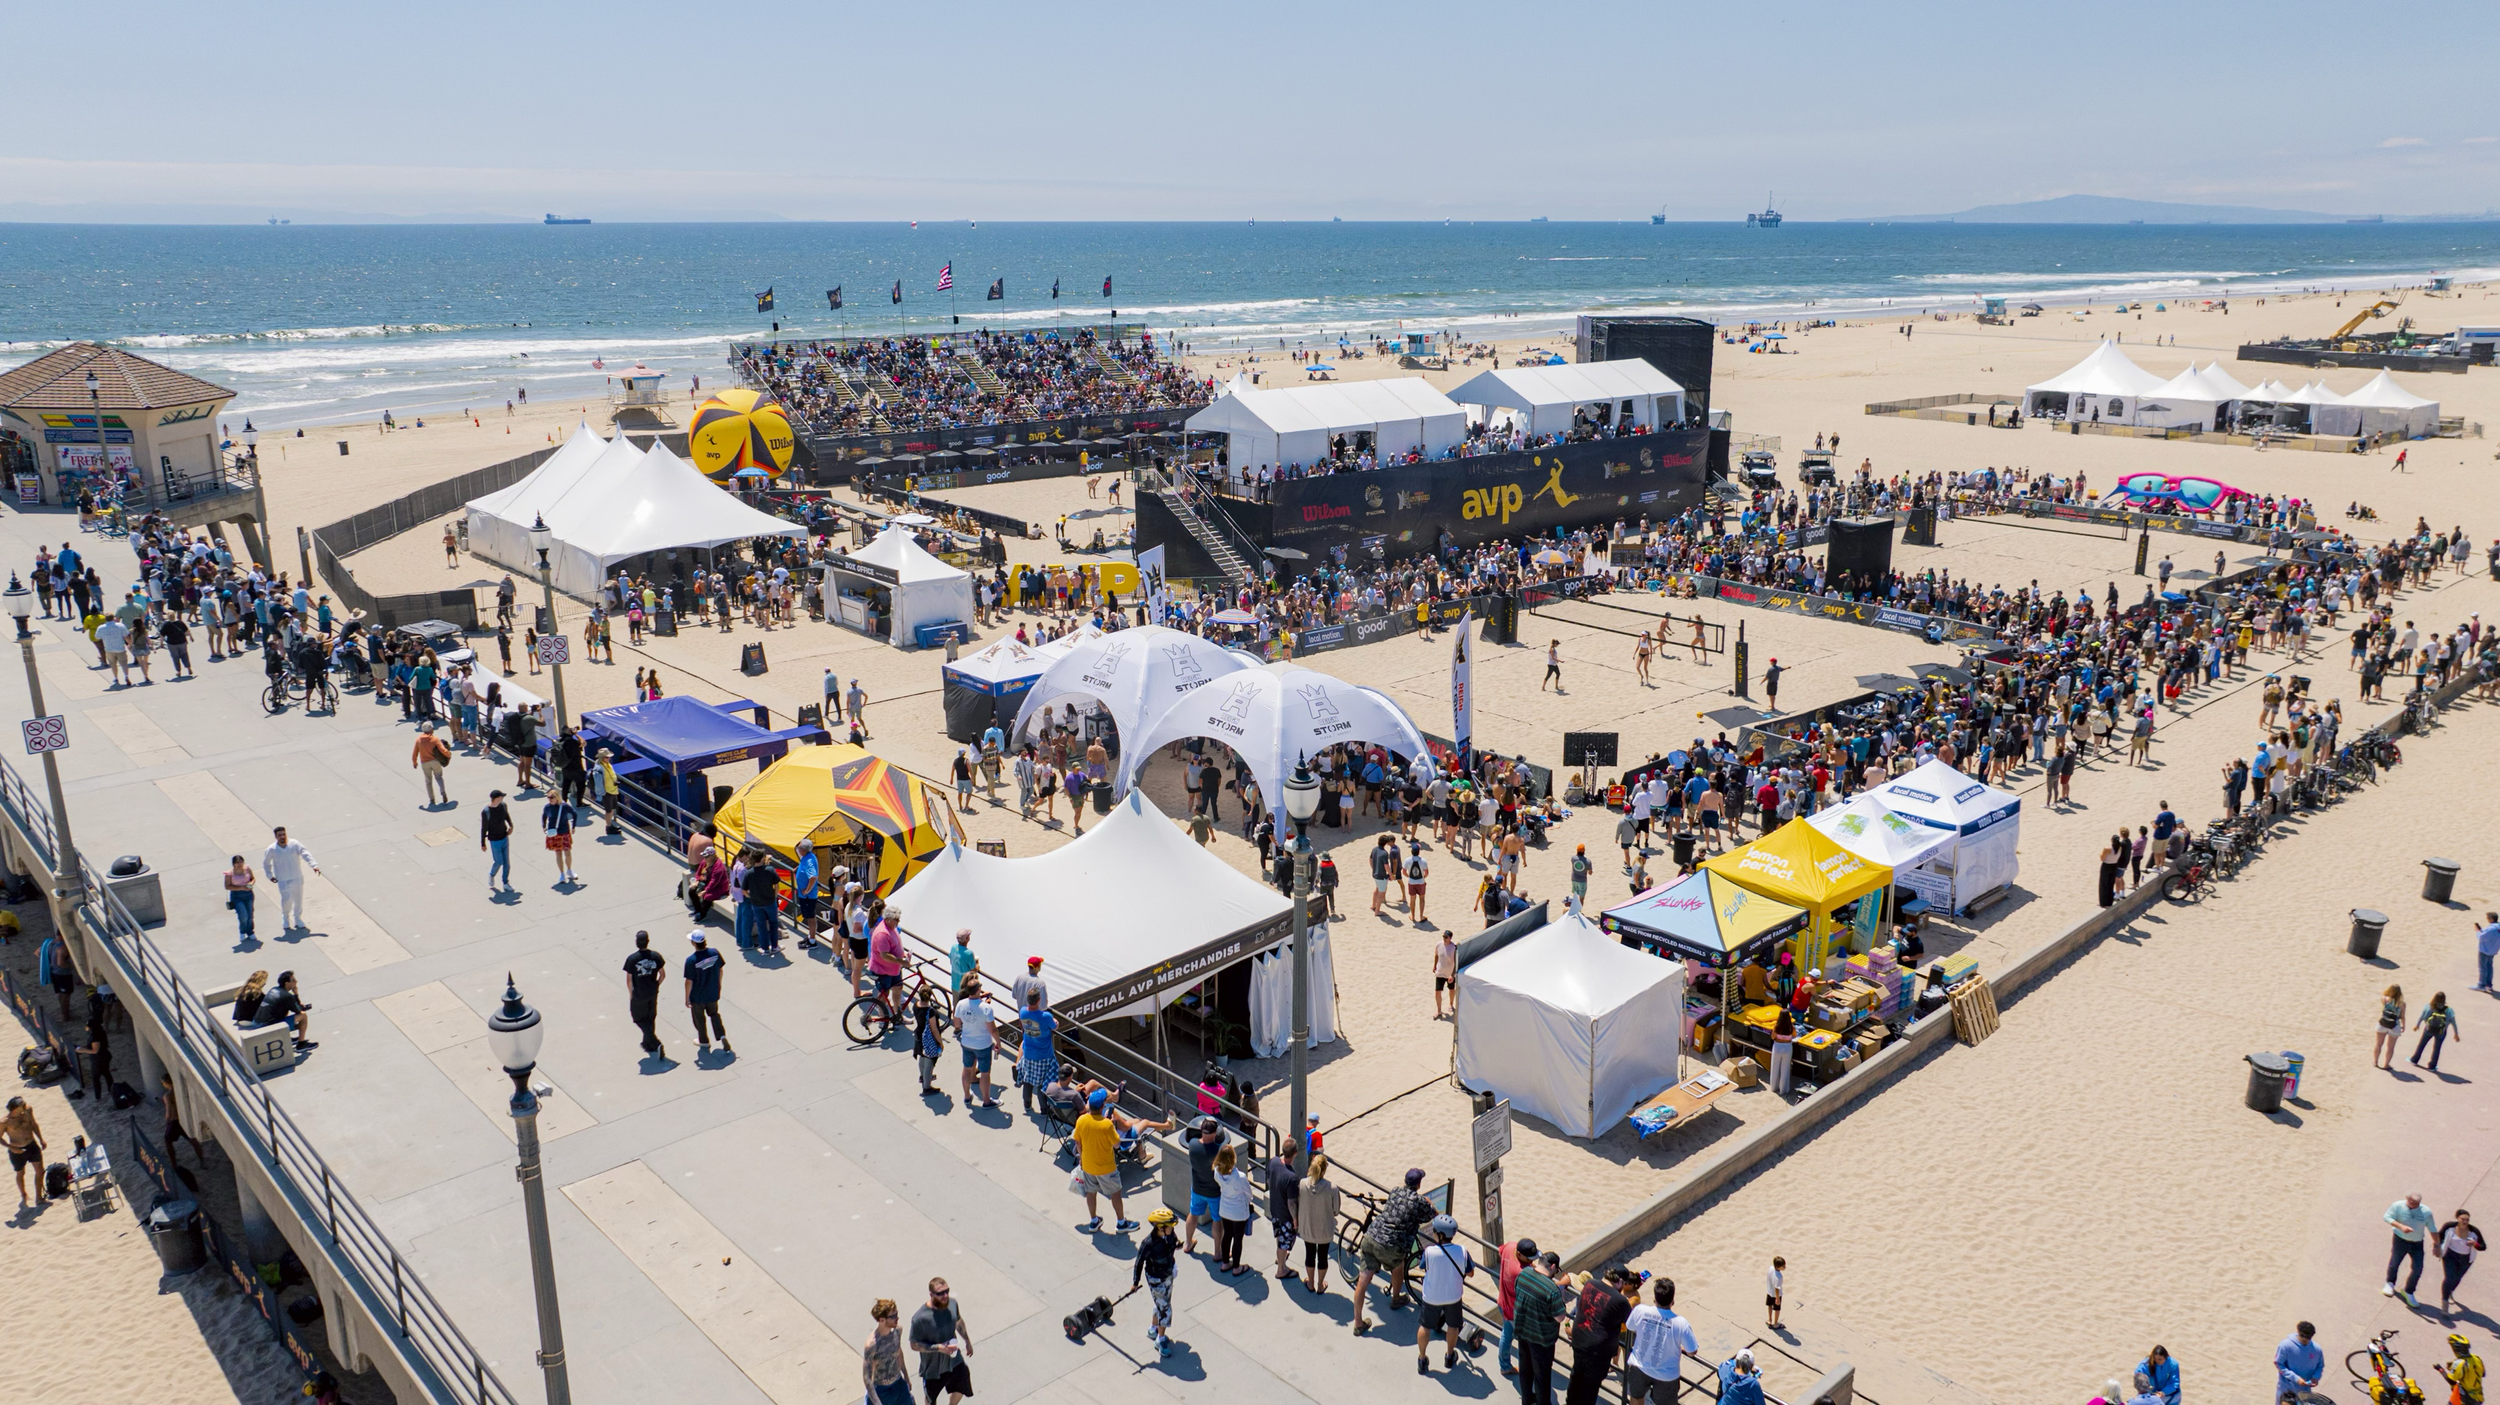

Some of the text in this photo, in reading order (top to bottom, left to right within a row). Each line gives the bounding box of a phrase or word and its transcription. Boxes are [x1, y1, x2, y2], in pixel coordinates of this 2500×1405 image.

[1028, 431, 1047, 442] avp
[706, 451, 721, 460] avp
[1662, 453, 1692, 468] Wilson
[986, 470, 1011, 483] goodr
[1302, 502, 1352, 522] Wilson
[1462, 483, 1523, 525] avp
[1806, 527, 1826, 543] goodr
[845, 561, 857, 571] BOX
[856, 565, 875, 576] OFFICE
[1721, 584, 1757, 603] Wilson
[1769, 595, 1791, 609] avp
[1823, 603, 1846, 617] avp
[1443, 605, 1460, 619] avp
[1882, 611, 1922, 627] local motion
[1308, 631, 1341, 644] local motion
[1357, 618, 1388, 641] goodr
[1082, 674, 1112, 690] STORM
[1207, 716, 1245, 736] STORM
[1313, 721, 1352, 736] STORM
[1893, 785, 1933, 802] local motion
[1746, 845, 1789, 868] lemon
[1814, 851, 1849, 873] lemon
[1622, 925, 1706, 957] MADE FROM RECYCLED MATERIALS
[1749, 941, 1761, 951] JOIN
[1761, 935, 1773, 945] THE
[1153, 965, 1164, 974] avp
[1066, 942, 1241, 1020] OFFICIAL AVP MERCHANDISE
[253, 1039, 285, 1065] HB
[287, 1331, 310, 1371] avp
